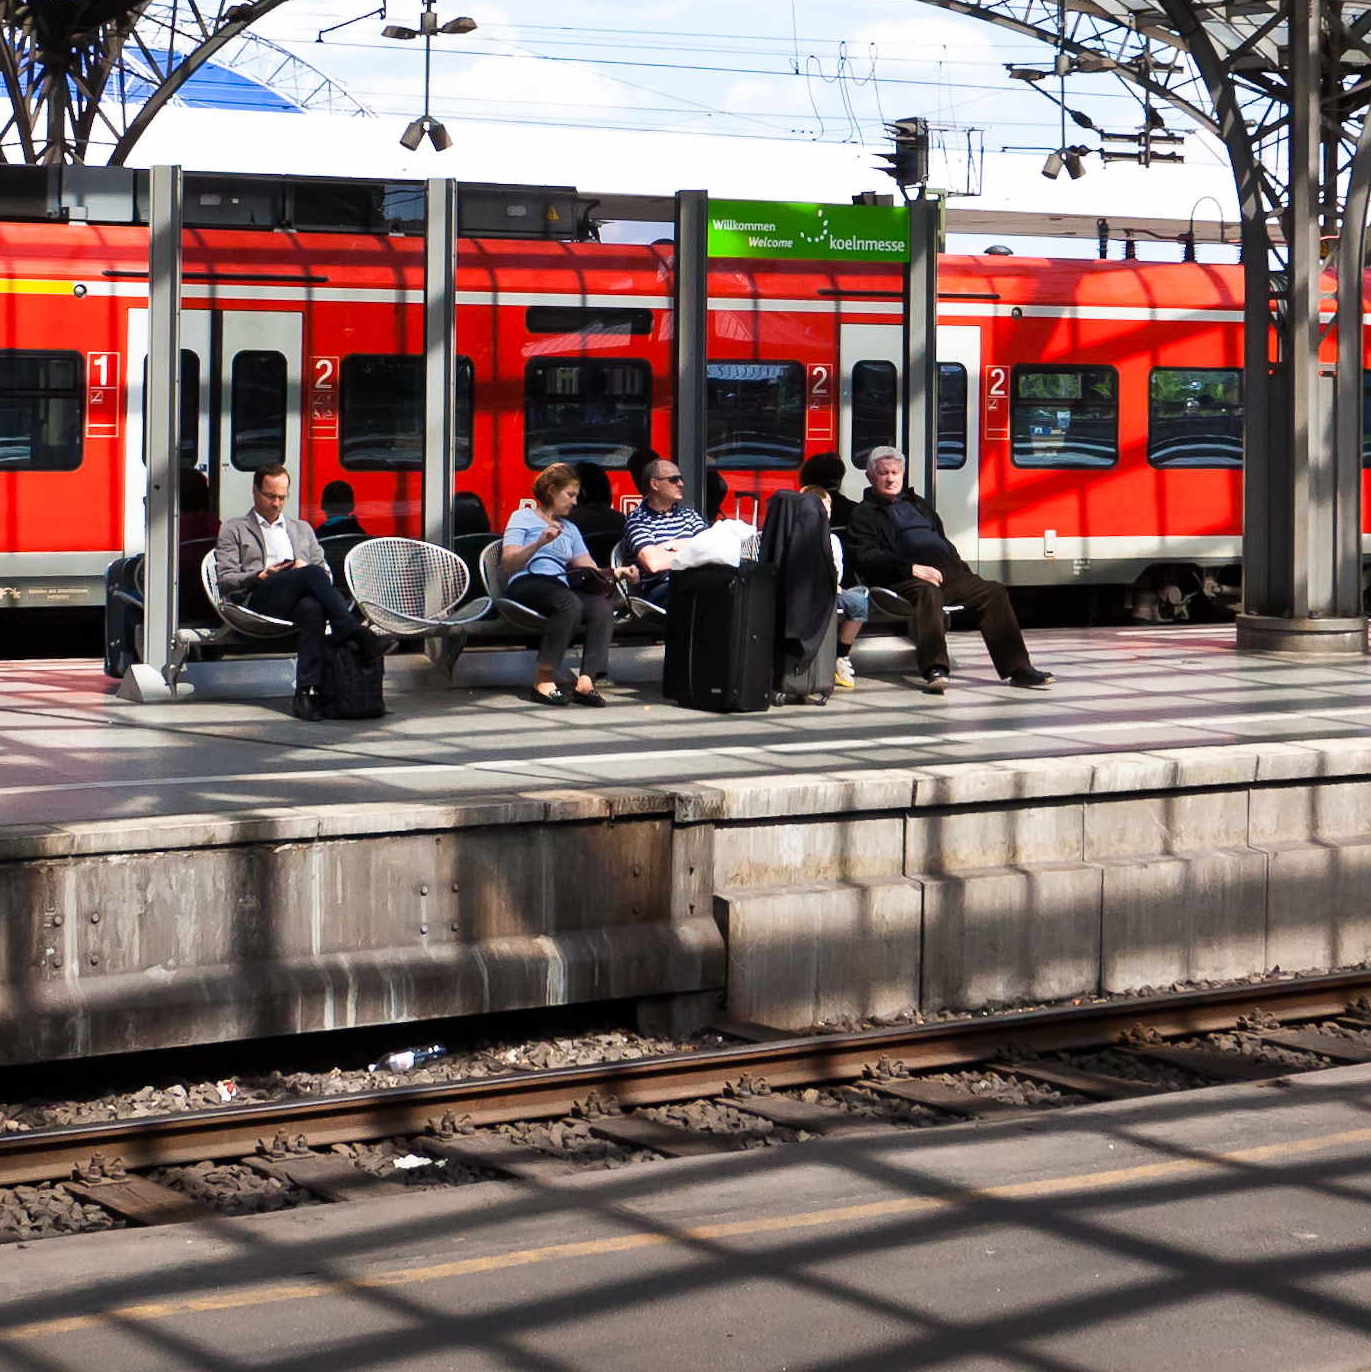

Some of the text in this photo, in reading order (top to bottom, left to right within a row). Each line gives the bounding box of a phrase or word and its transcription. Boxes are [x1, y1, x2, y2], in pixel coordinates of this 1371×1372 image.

[712, 219, 776, 232] Willkommen
[748, 236, 794, 249] Welcome
[829, 234, 906, 253] koelnmesse
[93, 354, 108, 387] 1
[314, 359, 333, 389] 2
[811, 366, 828, 395] 2
[990, 368, 1006, 396] 2
